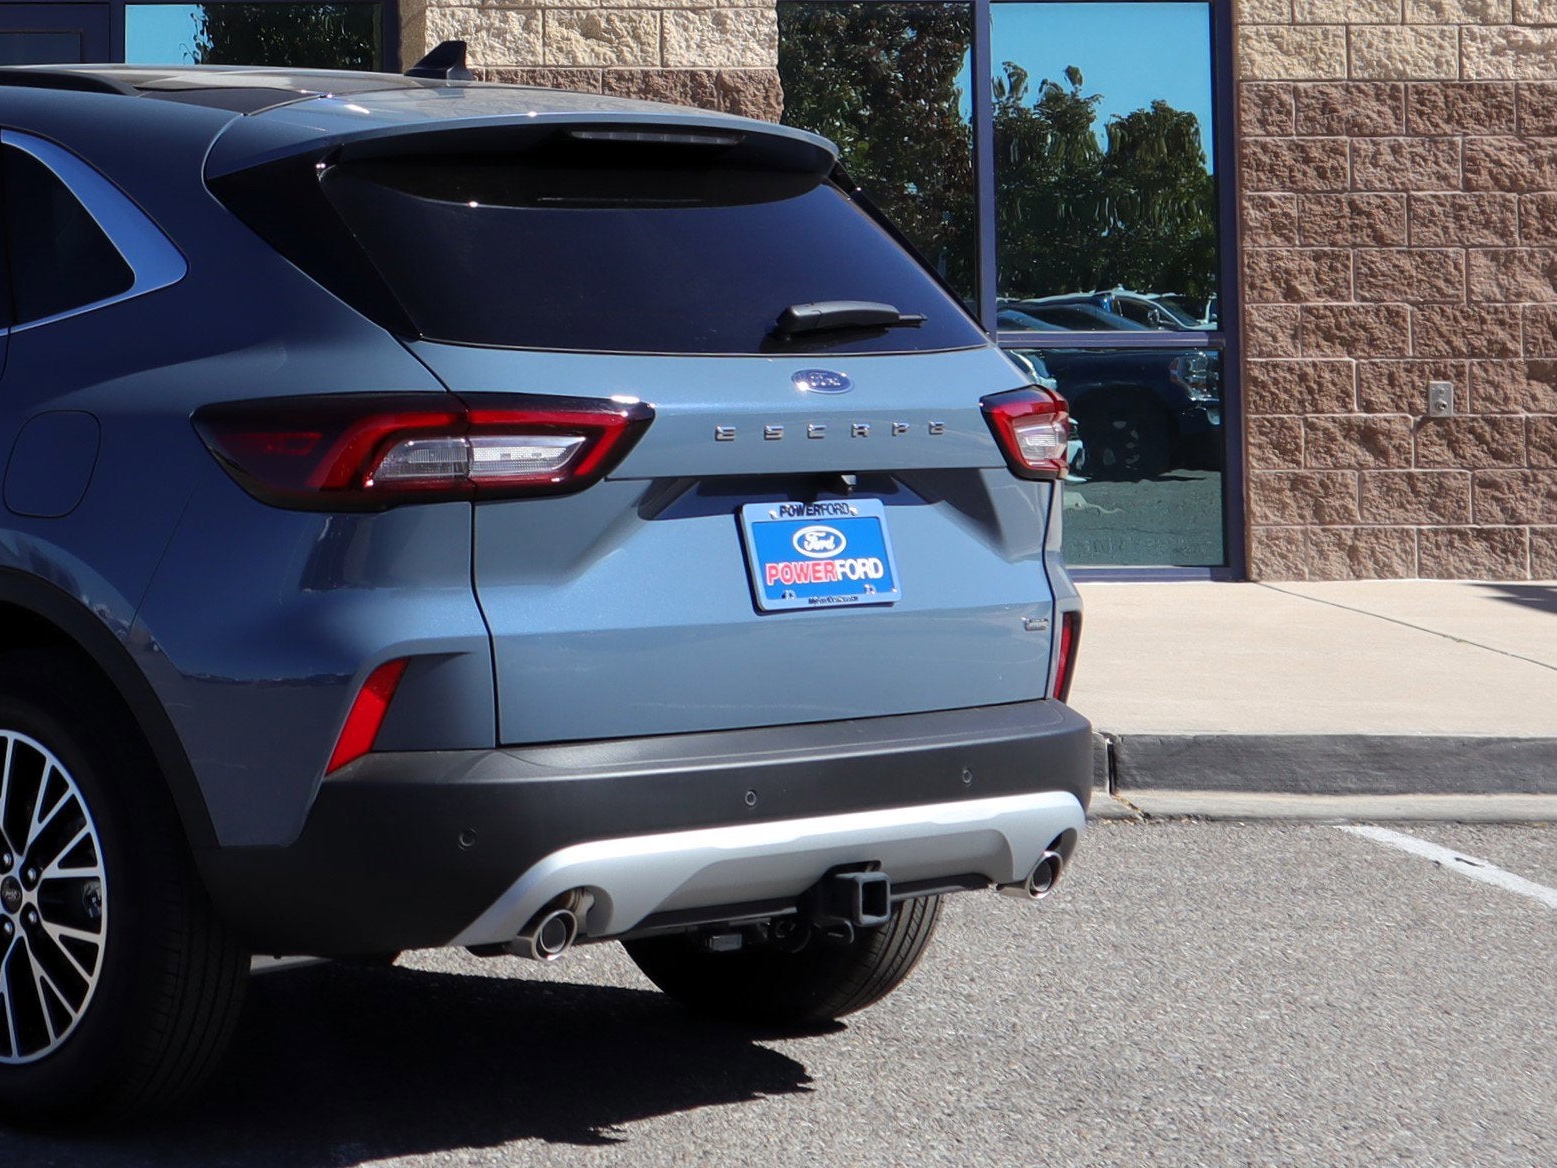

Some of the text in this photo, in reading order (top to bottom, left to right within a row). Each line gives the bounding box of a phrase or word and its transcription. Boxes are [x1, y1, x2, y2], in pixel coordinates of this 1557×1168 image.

[715, 421, 945, 441] ESCAPE
[803, 532, 836, 551] Ford
[766, 558, 884, 586] POWERFORD
